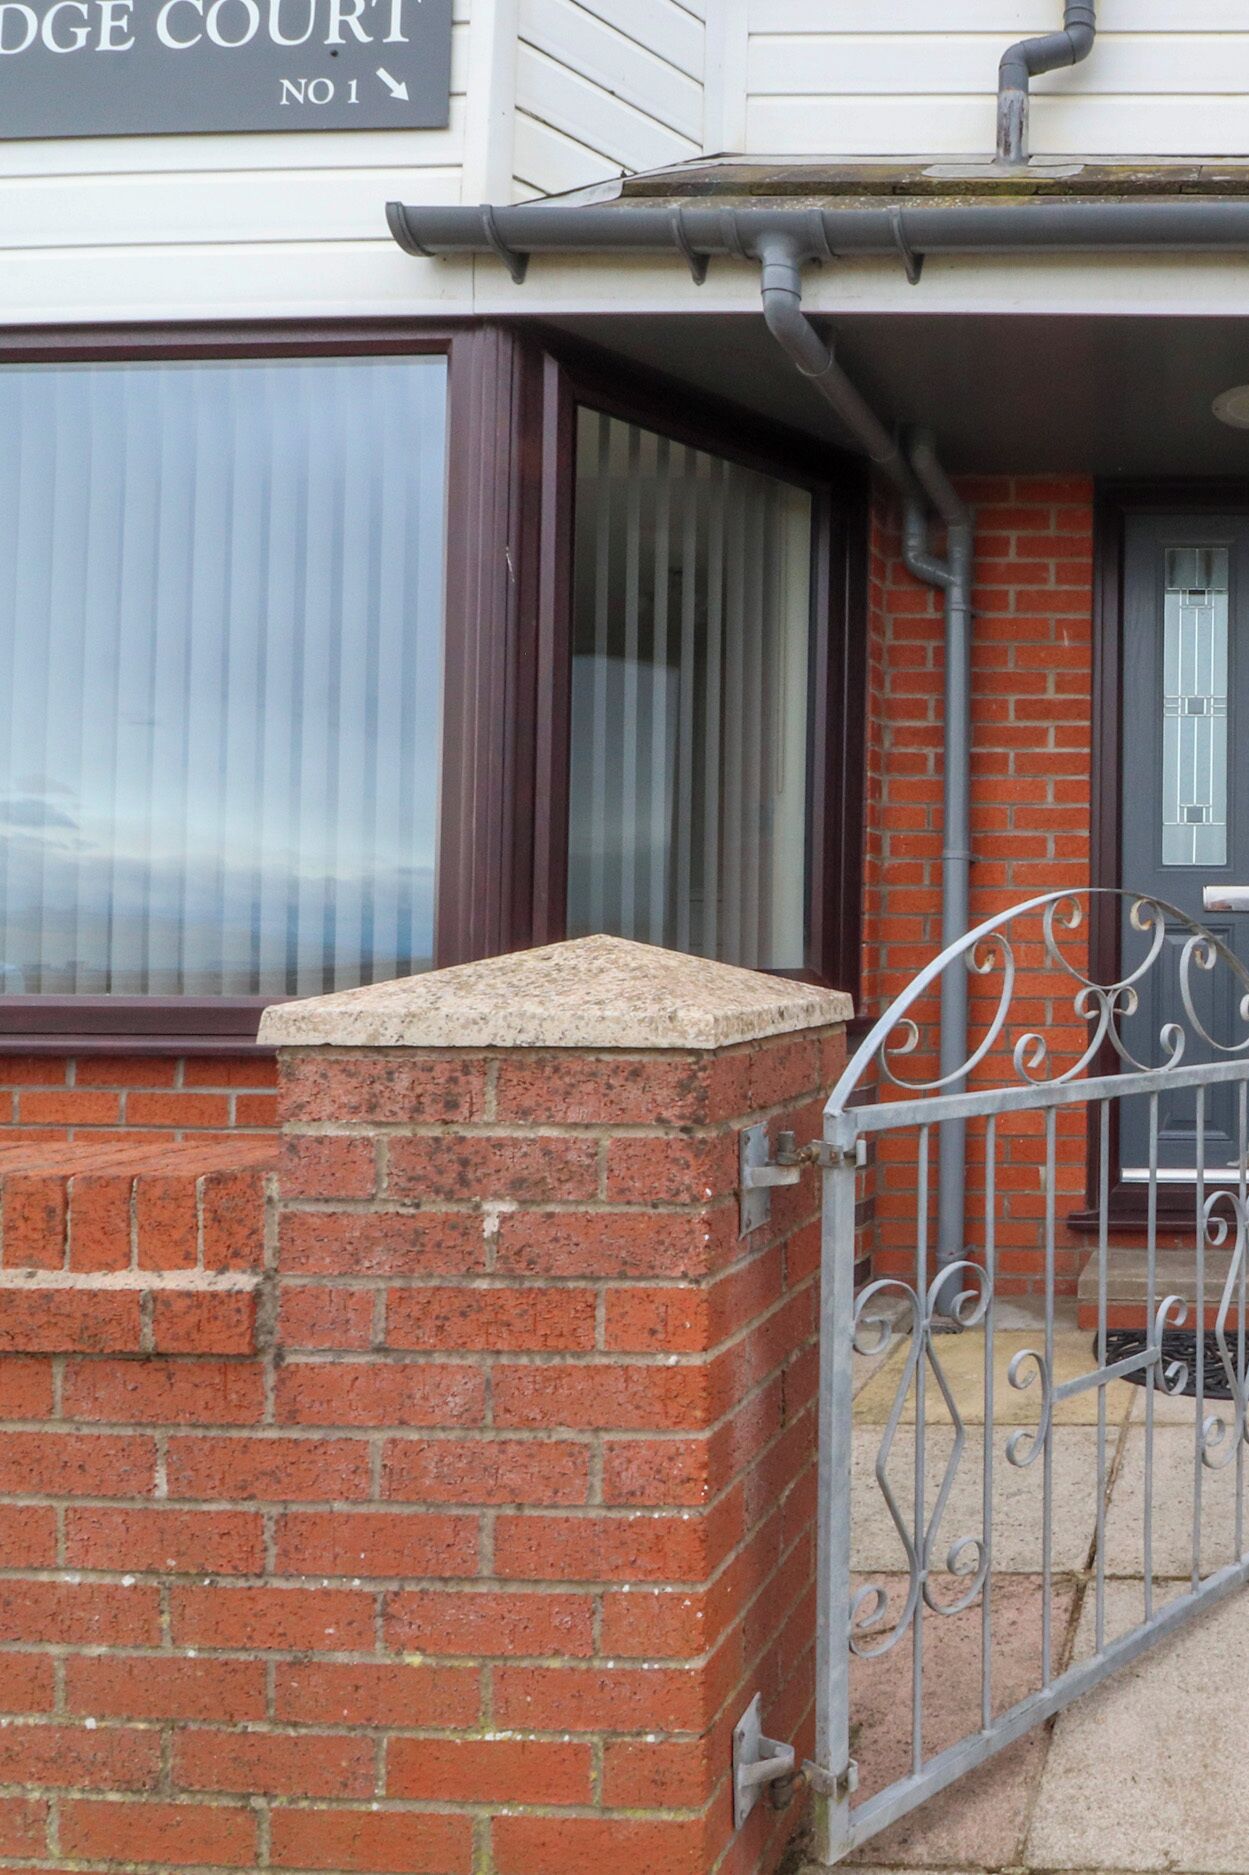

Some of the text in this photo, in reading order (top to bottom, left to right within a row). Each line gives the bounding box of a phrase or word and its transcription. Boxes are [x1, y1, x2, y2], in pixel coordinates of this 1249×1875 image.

[156, 0, 422, 49] COURT
[279, 78, 360, 105] NO 1
